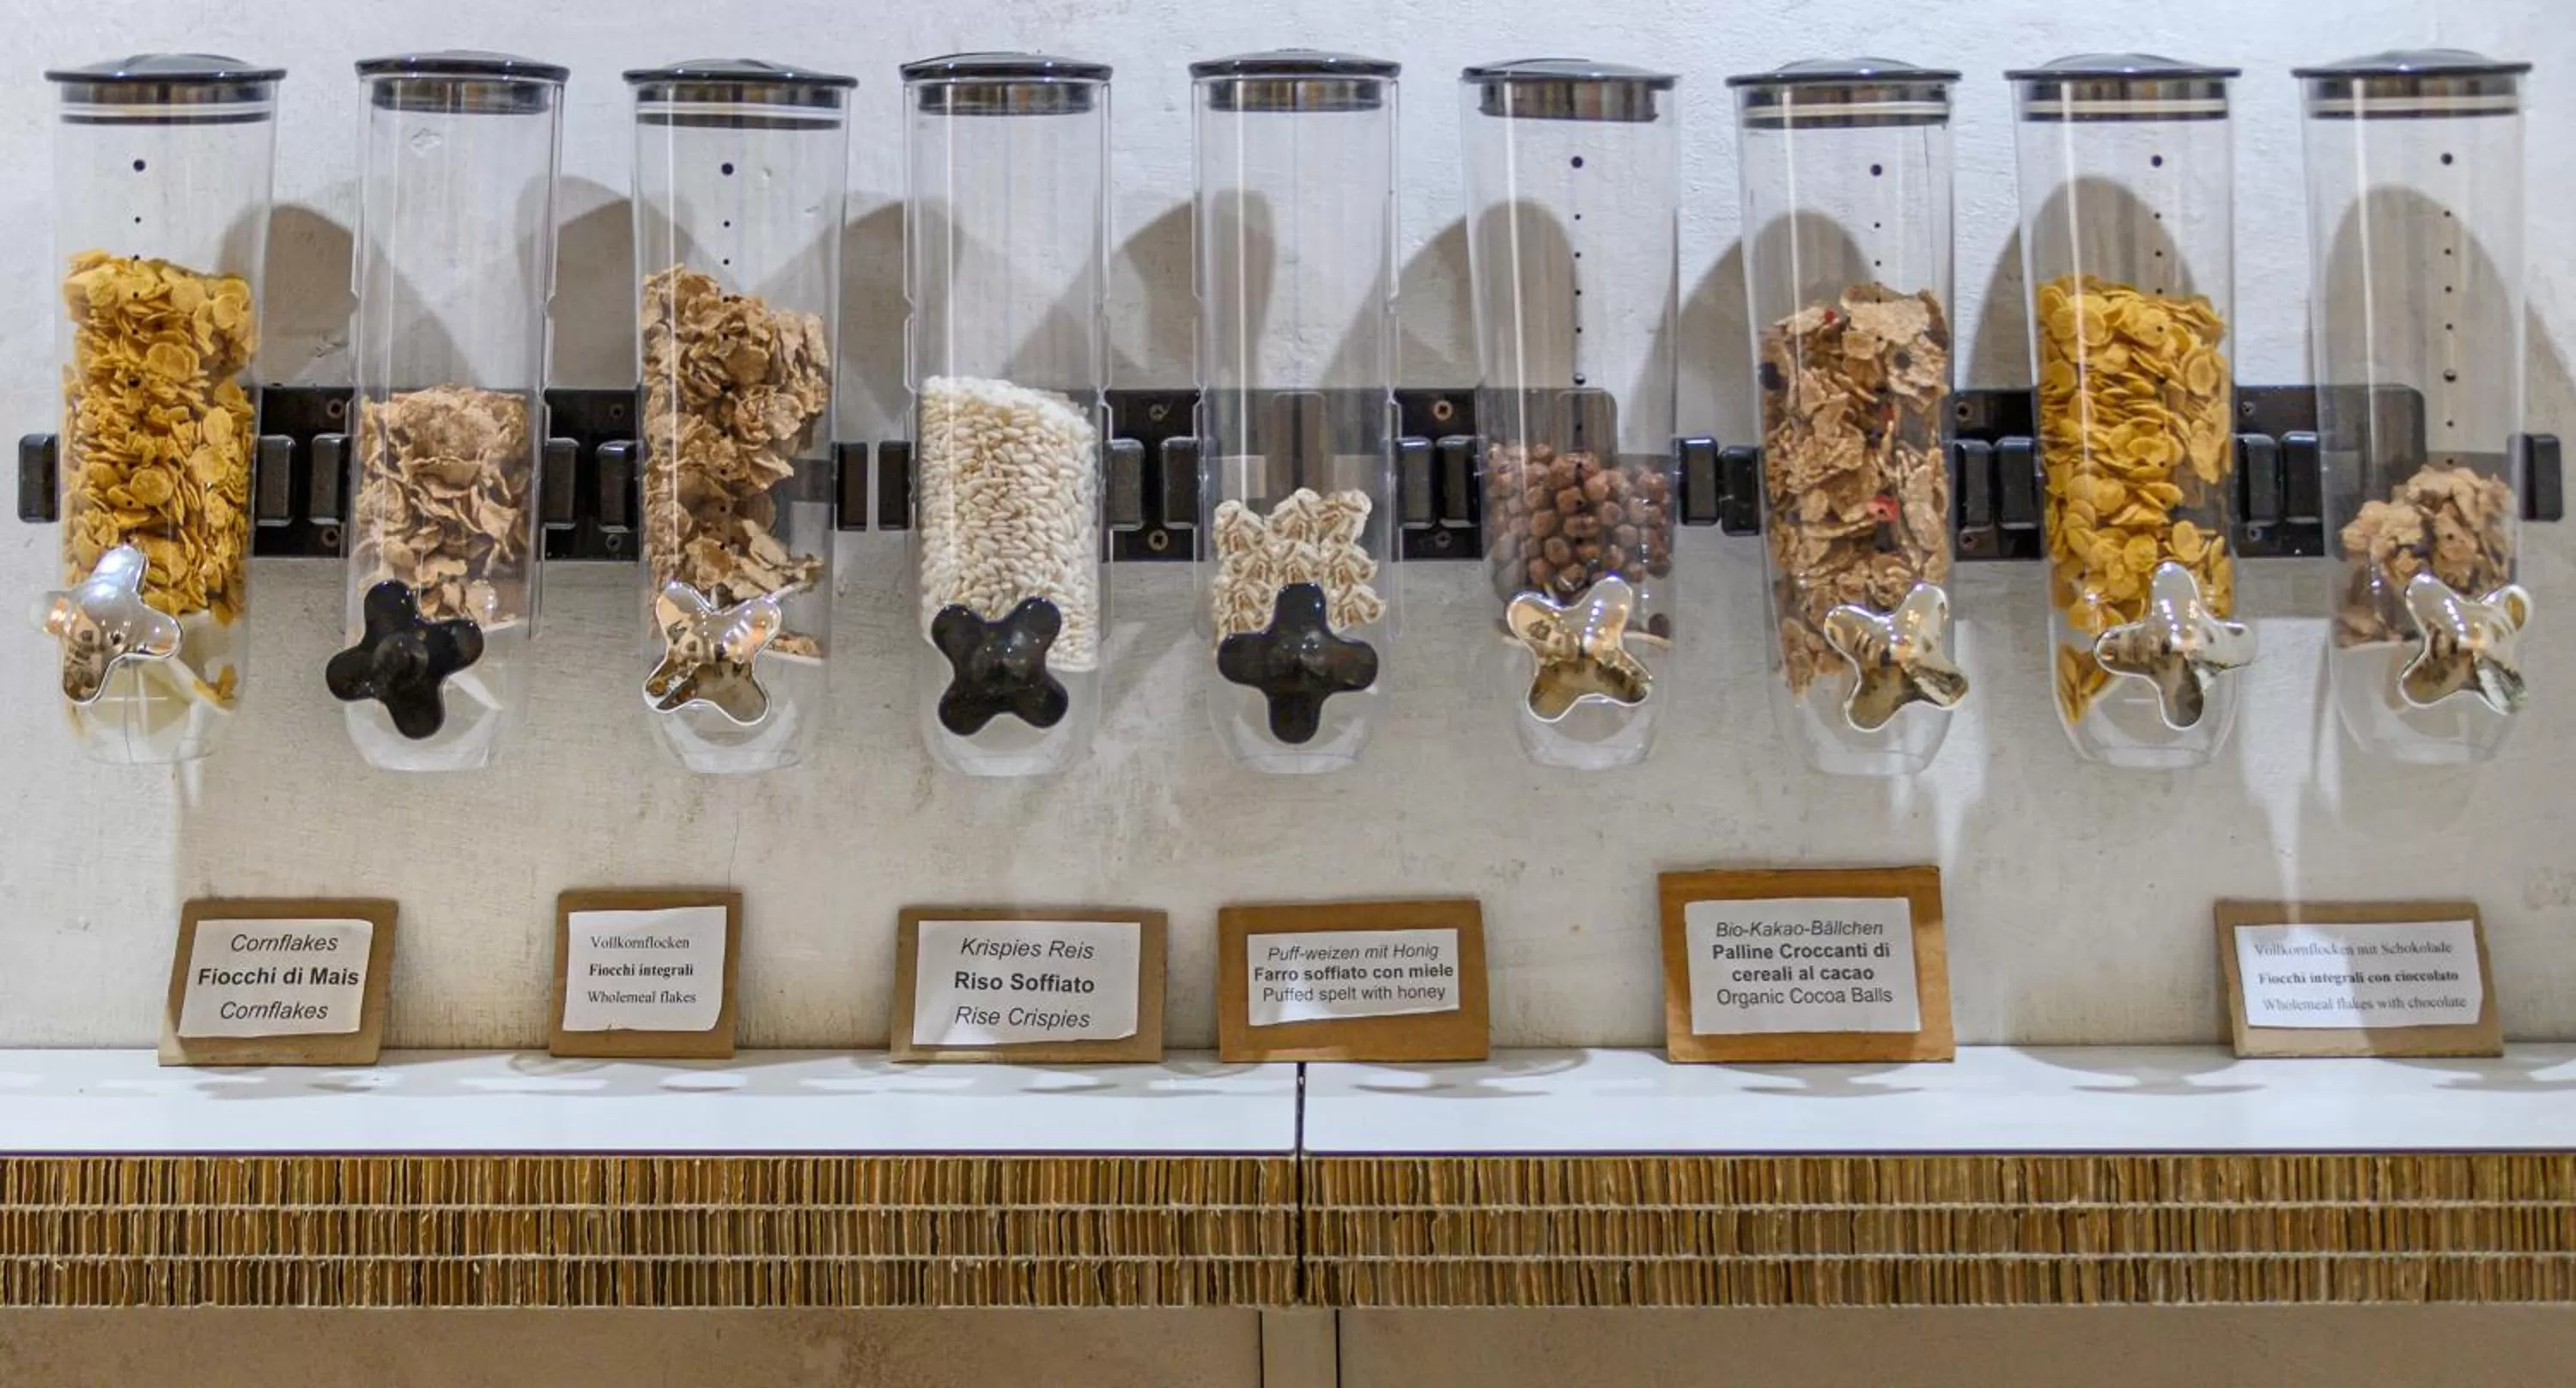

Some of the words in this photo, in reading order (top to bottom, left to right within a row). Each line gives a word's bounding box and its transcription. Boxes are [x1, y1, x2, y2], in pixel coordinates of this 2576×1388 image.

[1716, 920, 1883, 938] Bio-Kakao-Bällchen
[231, 934, 338, 952] Cornflakes
[591, 935, 690, 949] Vollkornflocken
[961, 938, 1042, 960] Krispies
[1048, 940, 1095, 959] Reis
[1713, 944, 1773, 959] Palline
[1779, 943, 1868, 959] Croccanti
[1873, 942, 1891, 957] di
[2254, 944, 2354, 957] Vollkornflocken
[2380, 941, 2452, 955] Schokolade
[1267, 946, 1360, 961] Puff-weizen
[1364, 945, 1388, 959] mit
[1394, 943, 1439, 960] Honig
[197, 966, 277, 985] Fiocchi
[283, 967, 302, 984] di
[309, 967, 359, 985] Mais
[589, 964, 635, 977] Fiocchi
[639, 964, 693, 979] integrali
[1254, 967, 1299, 982] Farro
[1304, 966, 1367, 981] soffiato
[1373, 967, 1404, 978] con
[1409, 964, 1454, 977] miele
[1732, 965, 1793, 982] cereali
[1799, 966, 1814, 980] al
[1820, 968, 1874, 981] cacao
[2258, 972, 2306, 984] Fiocchi
[2310, 971, 2364, 986] integrali
[2367, 973, 2391, 983] con
[2395, 971, 2459, 983] cioccolato
[954, 971, 1003, 990] Riso
[1010, 973, 1095, 994] Soffiato
[587, 991, 656, 1003] Wholemeal
[659, 991, 696, 1003] flakes
[1263, 987, 1313, 1002] Puffed
[1319, 986, 1356, 1003] spelt
[1362, 985, 1392, 1000] with
[1398, 984, 1446, 1000] honey
[1716, 989, 1783, 1009] Organic
[1789, 989, 1845, 1004] Cocoa
[1852, 987, 1893, 1003] Balls
[220, 1001, 329, 1020] Cornflakes
[2263, 997, 2333, 1011] Wholemeal
[2336, 996, 2374, 1010] flakes
[2377, 997, 2405, 1009] with
[2407, 995, 2467, 1008] chocolate
[955, 1006, 1000, 1026] Rise
[1008, 1008, 1091, 1031] Crispies
